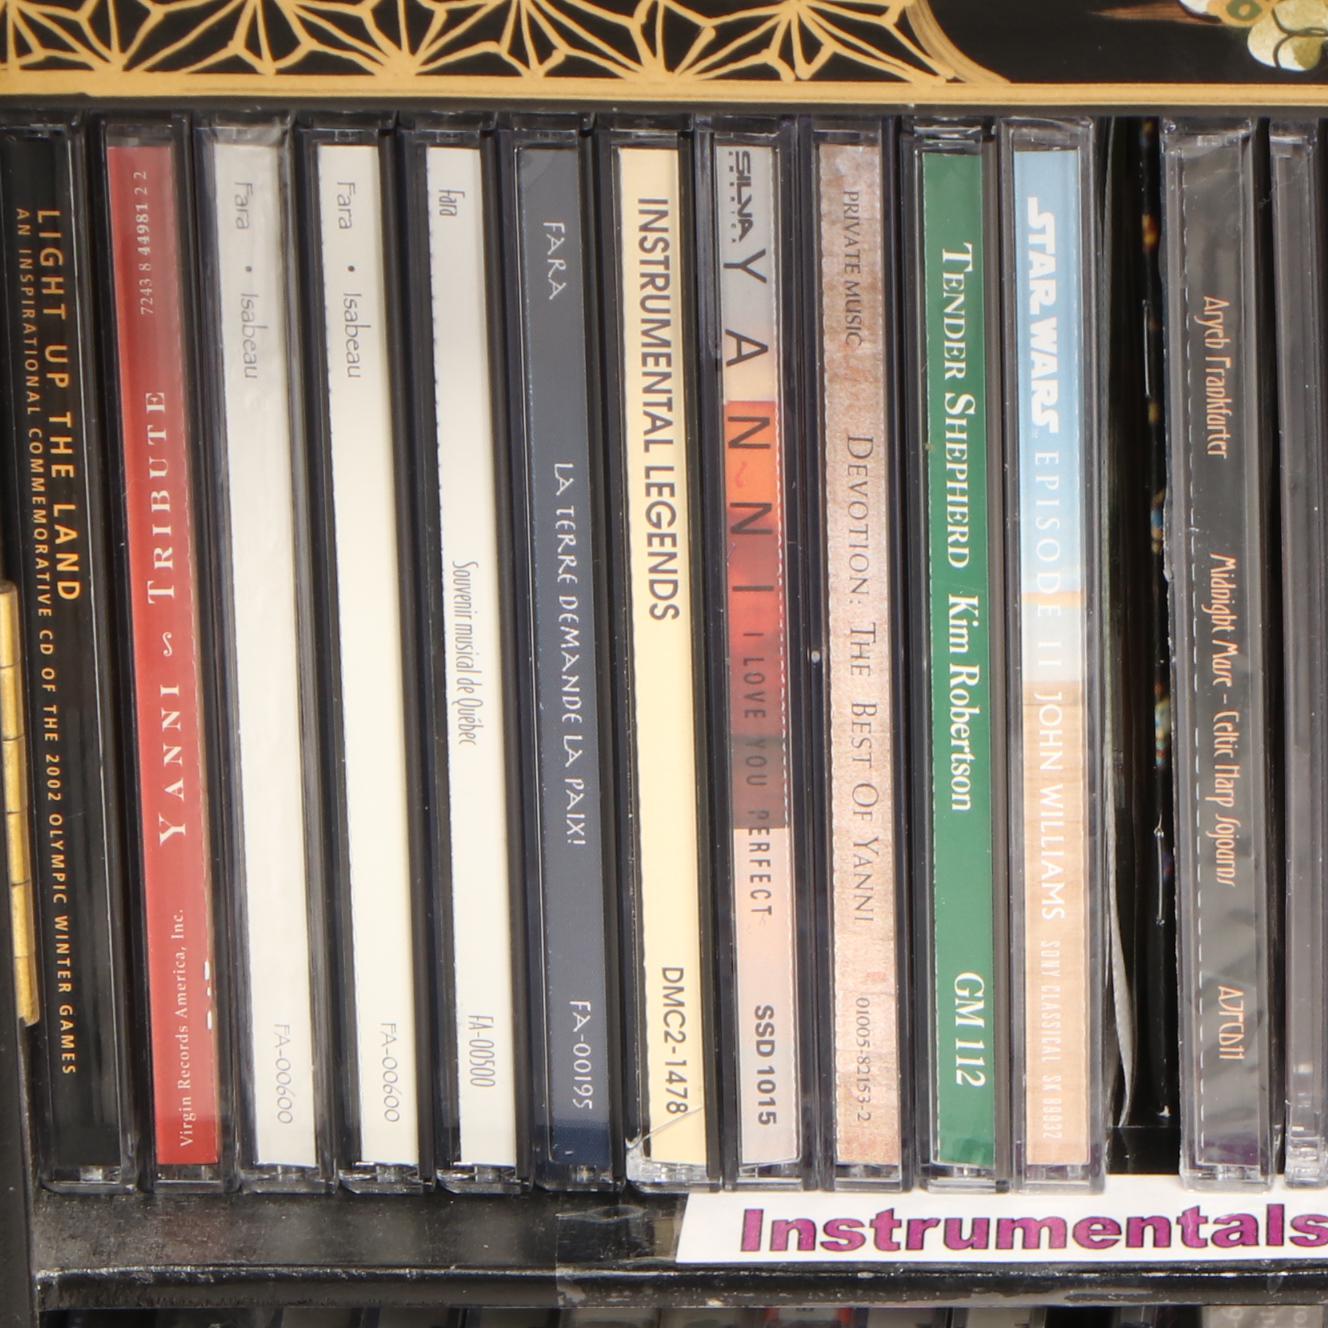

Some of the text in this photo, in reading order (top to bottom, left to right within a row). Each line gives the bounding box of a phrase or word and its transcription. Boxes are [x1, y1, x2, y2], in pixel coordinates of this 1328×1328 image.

[16, 208, 77, 1075] AN INSPIRATIONAL COMMEMORATIVE CD OF THE 2002 OLYMPIC WINTER GAMES
[37, 210, 81, 600] LIGHT UP THE LAND
[145, 392, 174, 604] TRIBUTE
[342, 292, 371, 378] Isabeau
[544, 222, 594, 1109] FARA LA TERRE DEMANDE LA PAIX! FA-00195
[638, 199, 687, 1114] INSTRUMENTAL LEGENDS DMC2-1478
[942, 243, 986, 1086] TENDER SHEPHERD Kim Robertson GM 112
[1028, 197, 1065, 920] STAR WARS EPISODE JOHN WILLIAMS
[755, 1005, 777, 1126] SSD 1015
